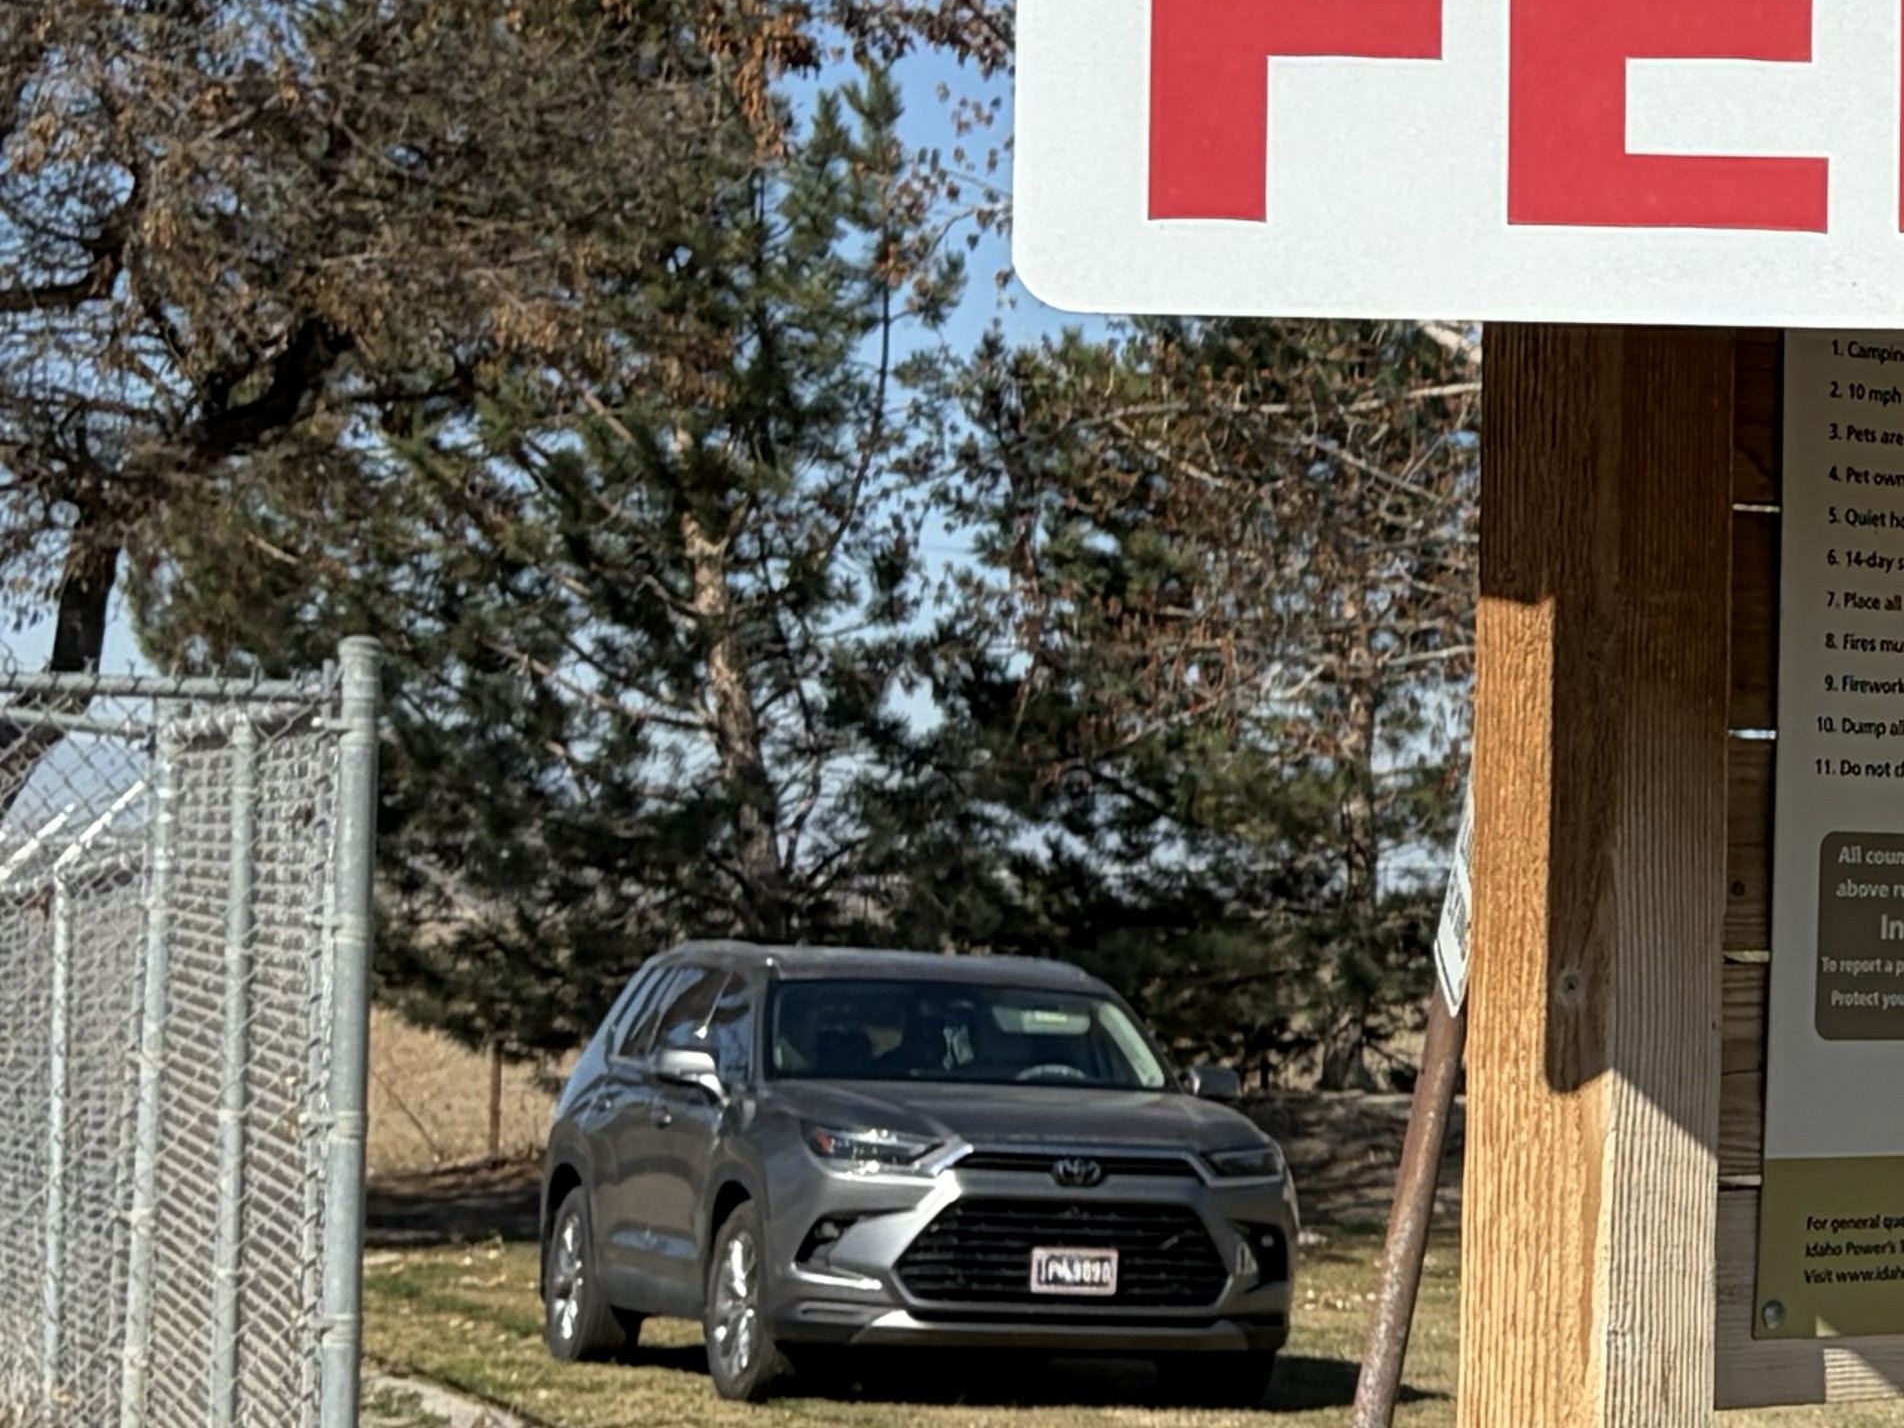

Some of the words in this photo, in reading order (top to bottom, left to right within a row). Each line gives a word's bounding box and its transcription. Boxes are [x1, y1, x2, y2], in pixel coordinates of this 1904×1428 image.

[1829, 379, 1841, 399] 2.
[1848, 382, 1865, 400] 10
[1868, 385, 1902, 407] mph
[1829, 422, 1844, 441] 3.
[1846, 423, 1877, 443] Pets
[1880, 430, 1904, 447] are
[1824, 673, 1839, 692] 9.
[1838, 844, 1861, 864] All
[1835, 877, 1889, 898] above
[1881, 913, 1904, 940] In
